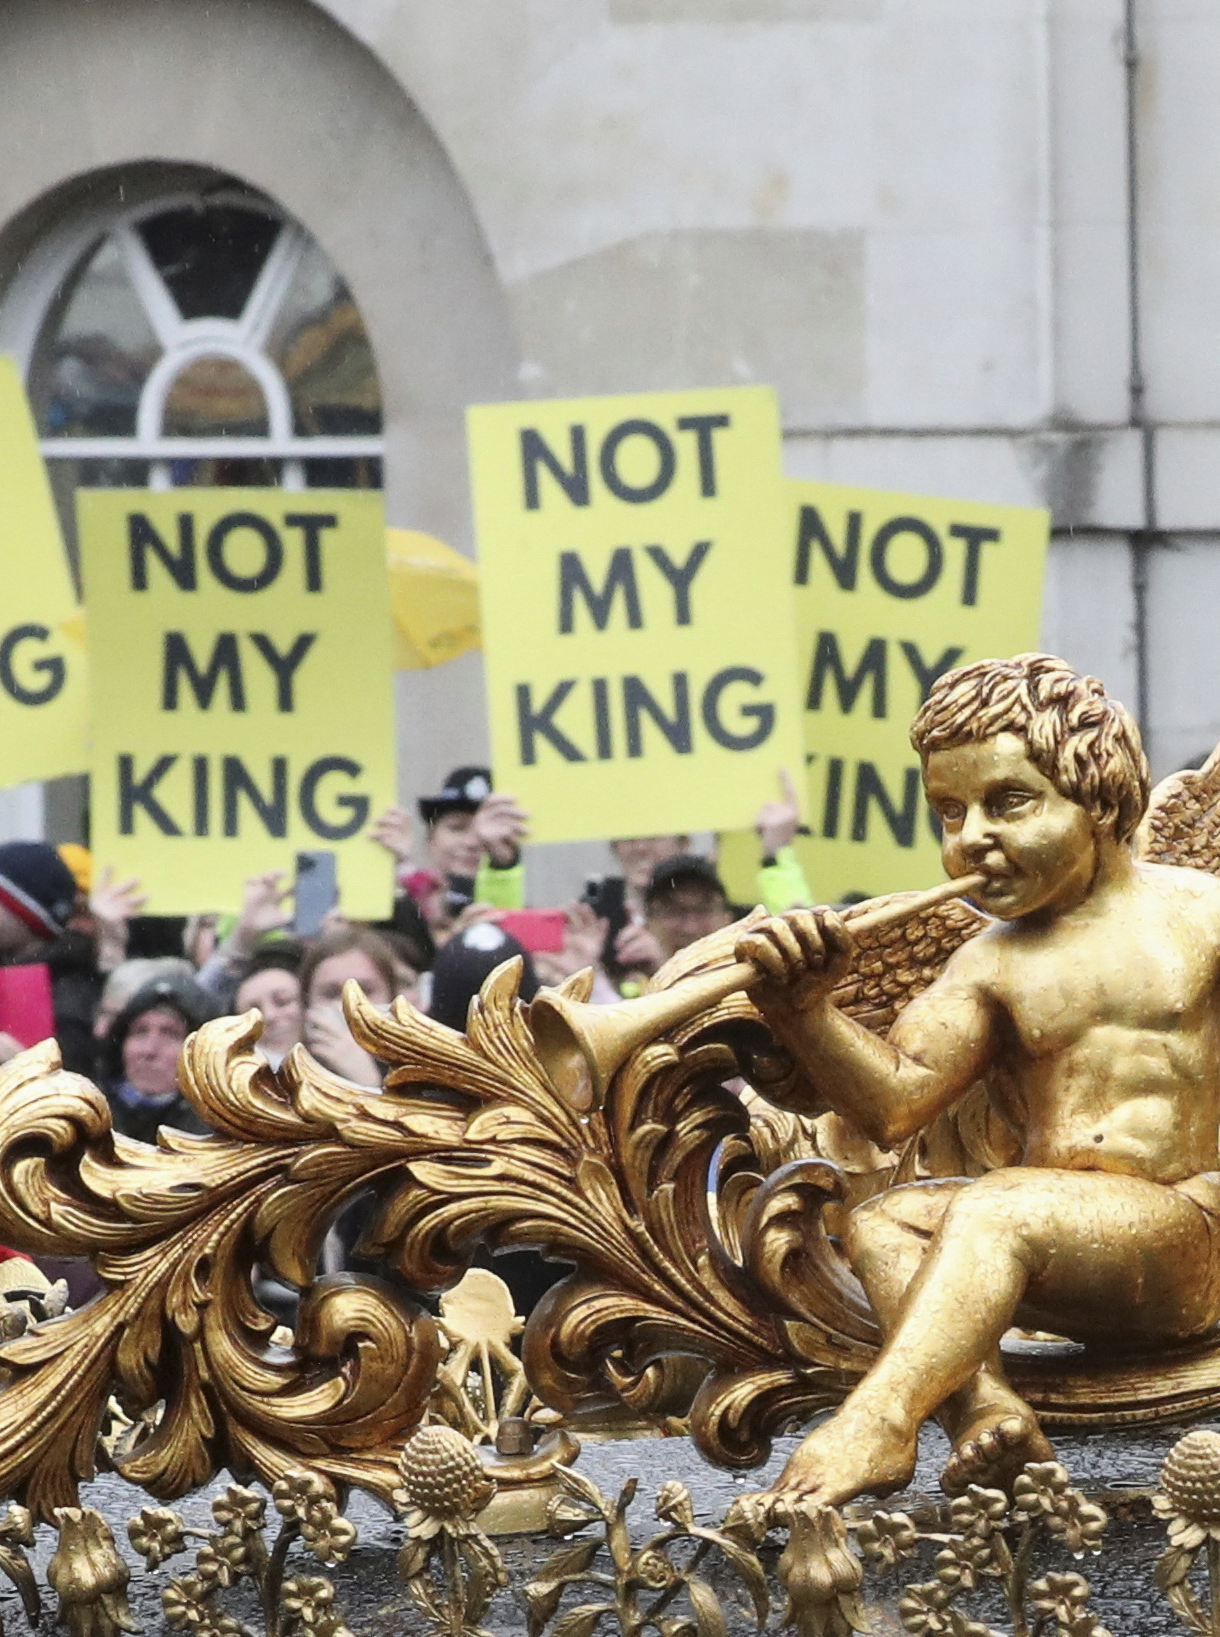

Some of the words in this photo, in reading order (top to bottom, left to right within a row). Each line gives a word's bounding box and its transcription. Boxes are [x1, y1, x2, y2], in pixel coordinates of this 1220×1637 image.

[521, 414, 730, 509] NOT
[127, 512, 339, 594] NOT
[560, 542, 713, 634] MY
[794, 503, 1001, 607] NOT
[161, 631, 316, 713] MY
[517, 667, 776, 766] KING
[118, 754, 370, 840] KING
[795, 753, 943, 848] IN
